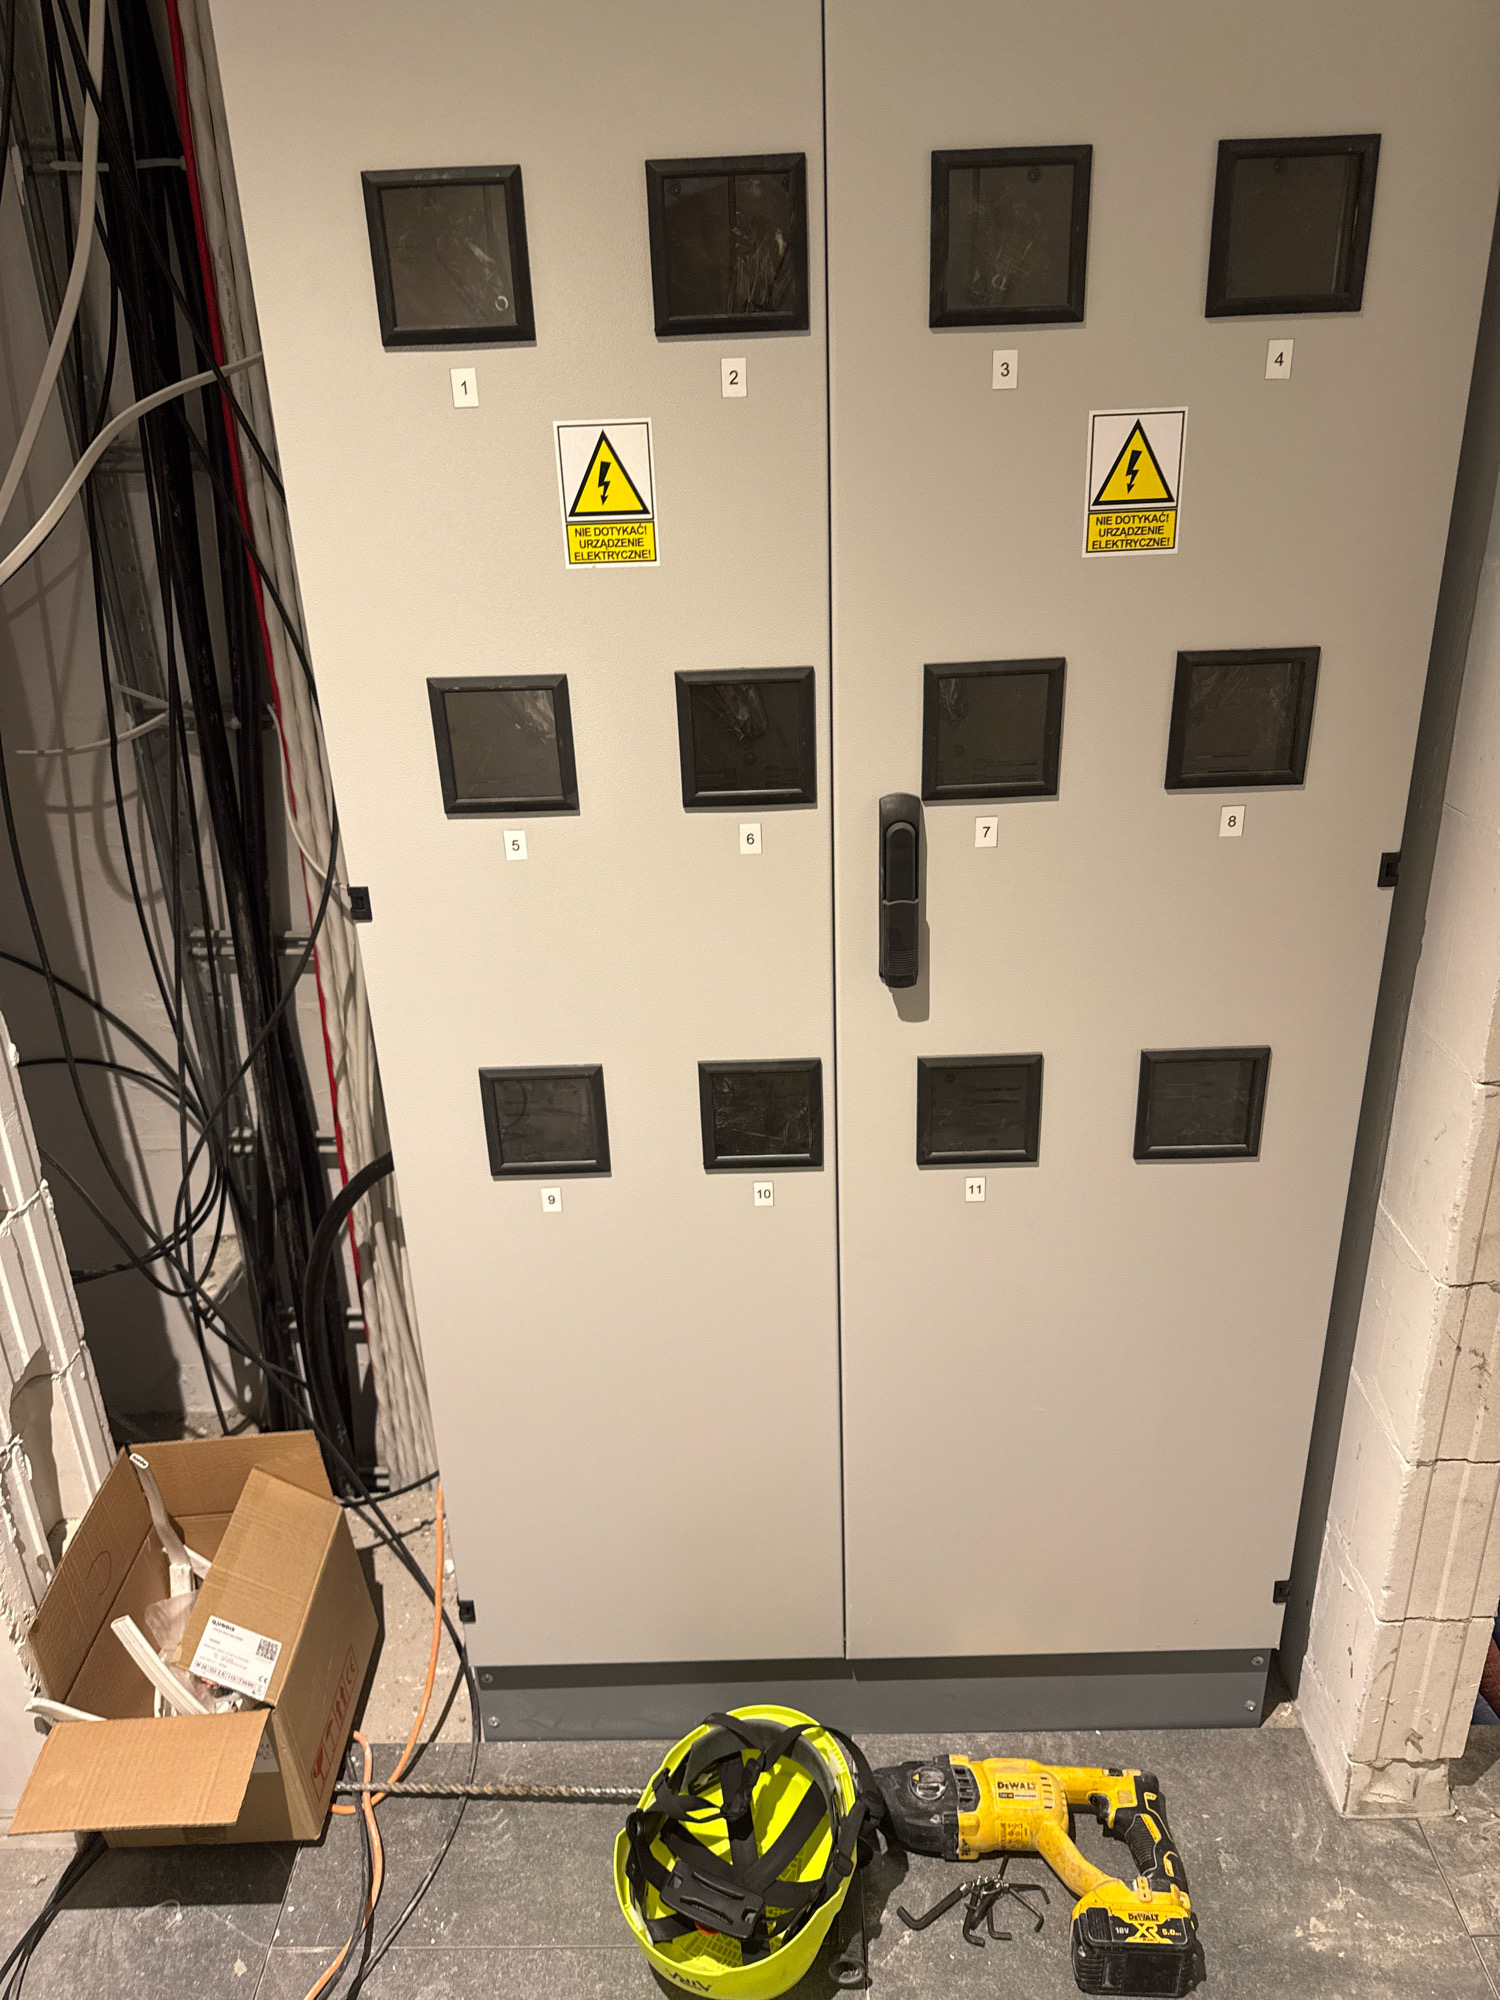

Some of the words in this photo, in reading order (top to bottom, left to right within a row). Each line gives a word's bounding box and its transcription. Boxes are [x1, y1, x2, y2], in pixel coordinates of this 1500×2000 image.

[1274, 351, 1285, 367] 4
[1000, 362, 1010, 378] 3
[730, 369, 739, 385] 2
[461, 380, 468, 395] 1
[1095, 516, 1113, 526] NIE
[1115, 511, 1169, 525] DOTYKAĆ!
[574, 527, 592, 537] NIE
[594, 522, 647, 536] DOTYKAĆ!
[1098, 525, 1165, 538] URZĄDZENIE
[579, 537, 645, 550] URZĄDZENIE
[1091, 537, 1170, 550] ELEKTRYCZNE!
[574, 549, 651, 561] ELEKTRYCZNE!
[1227, 815, 1237, 828] 8
[982, 826, 991, 838] 7
[511, 839, 520, 851] 5
[746, 833, 755, 845] 6
[757, 1188, 772, 1199] 10
[968, 1184, 982, 1195] 11
[547, 1194, 556, 1205] 9
[1115, 1926, 1130, 1935] 18V
[1134, 1922, 1162, 1939] XR
